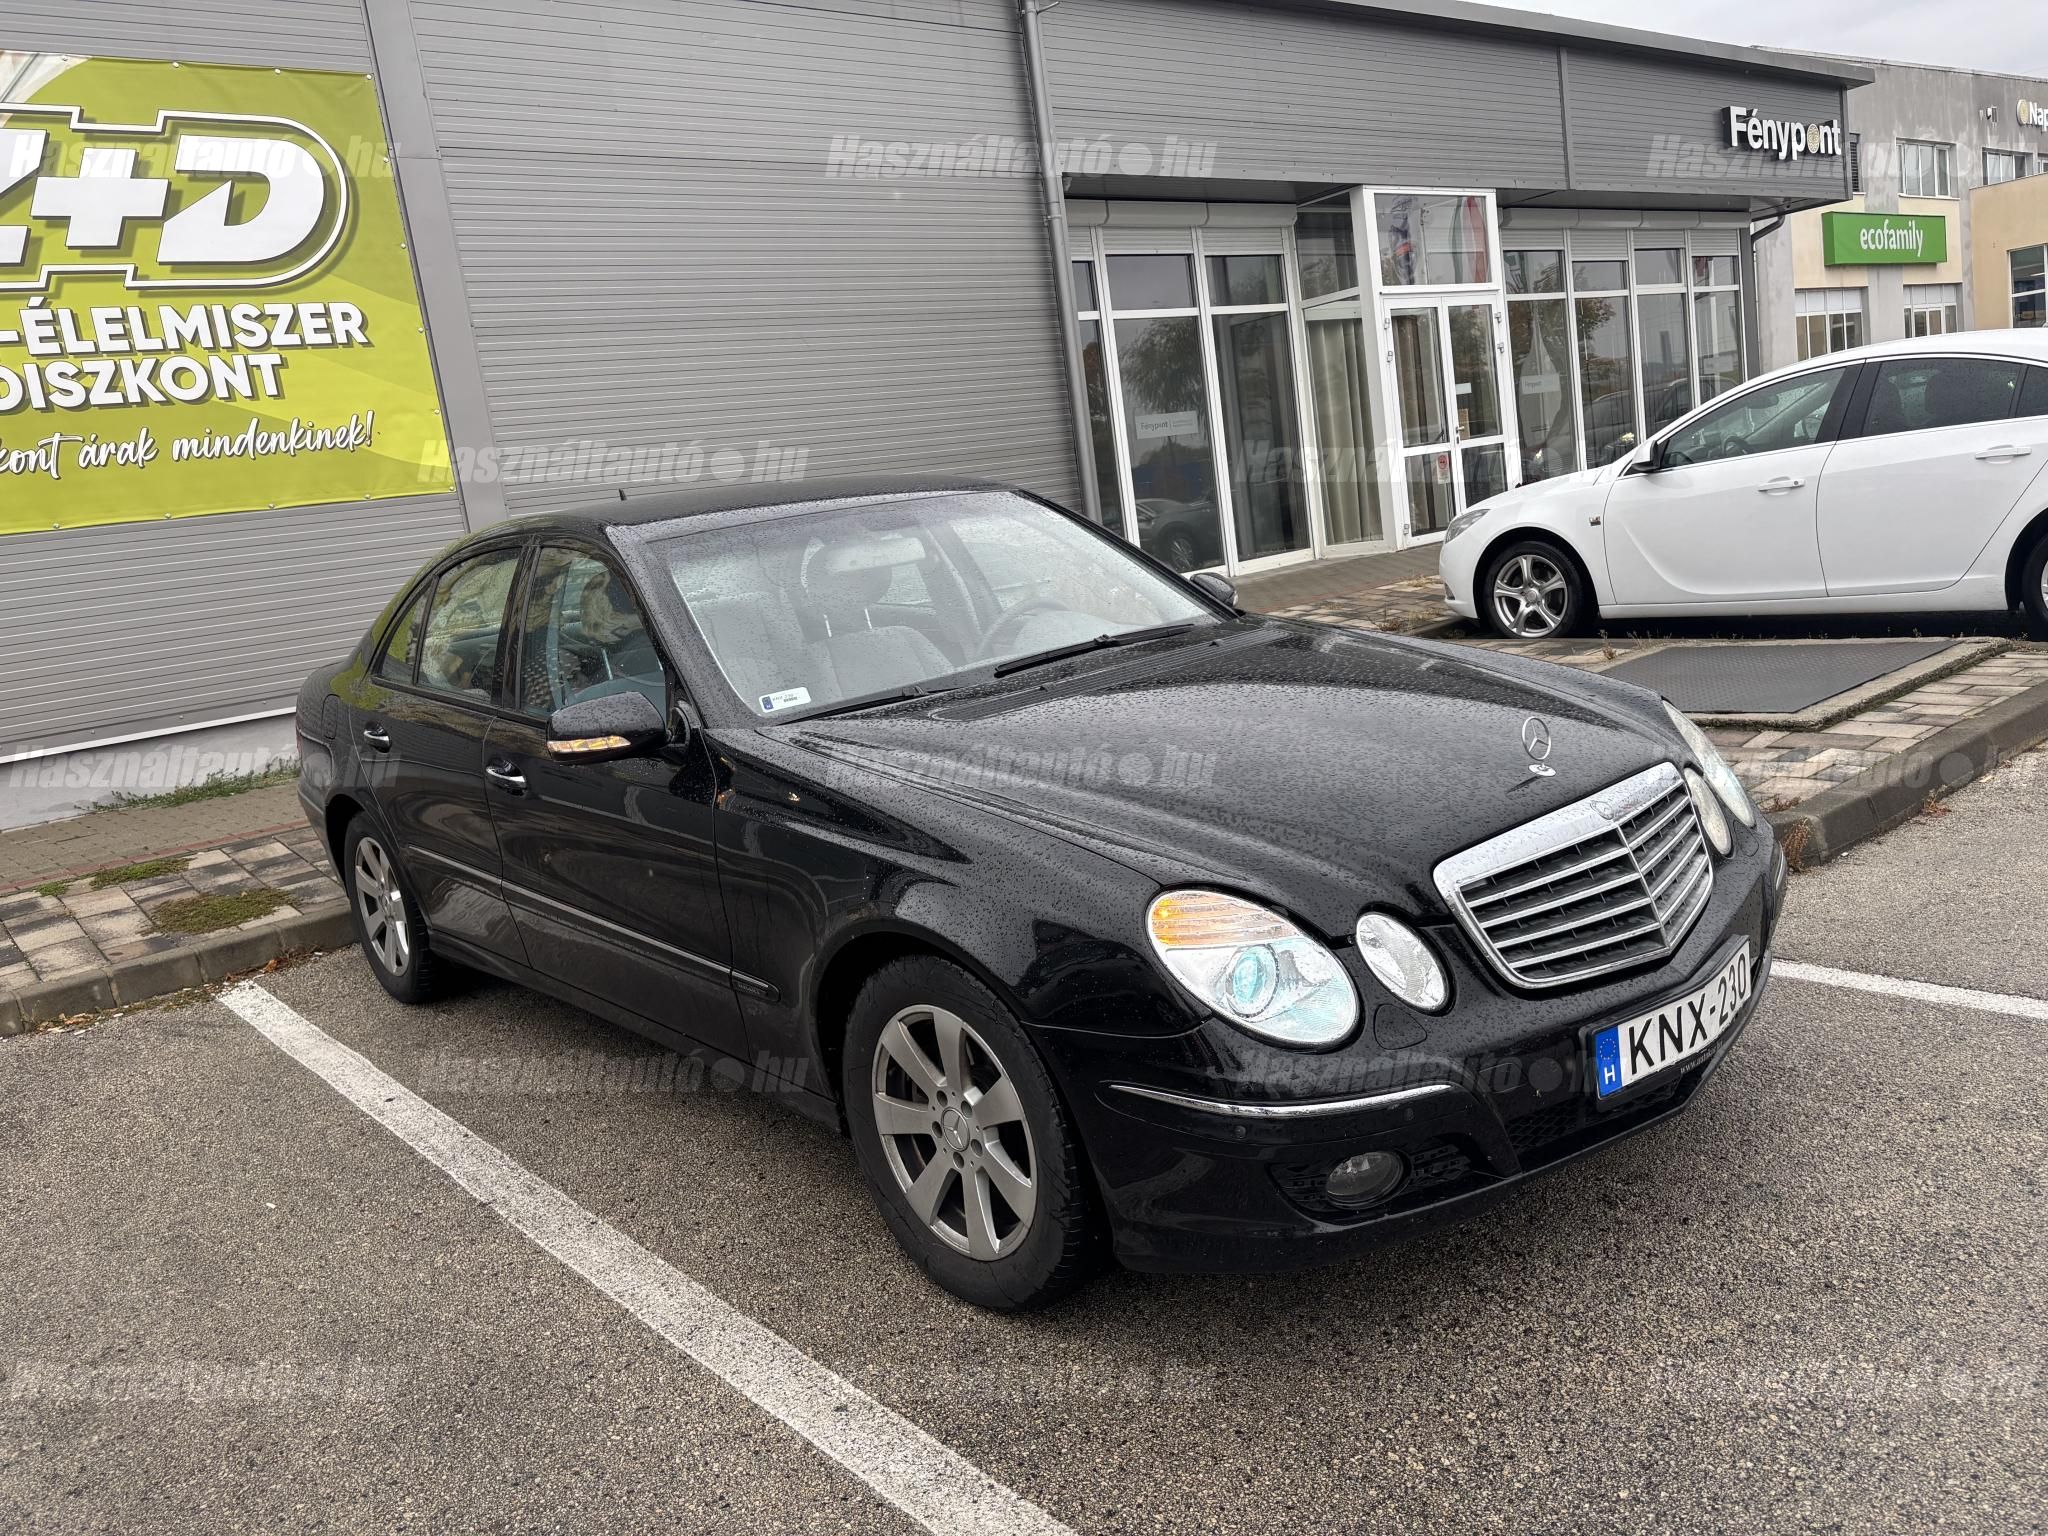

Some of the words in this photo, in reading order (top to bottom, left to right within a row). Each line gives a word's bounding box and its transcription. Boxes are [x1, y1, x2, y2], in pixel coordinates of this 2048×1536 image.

[1730, 106, 1841, 160] Fénypont
[1860, 219, 1923, 257] ecofamily
[78, 428, 158, 468] árak
[172, 410, 376, 461] mindenkinek!
[1628, 953, 1747, 1075] KNX-230
[1604, 1065, 1616, 1084] H
